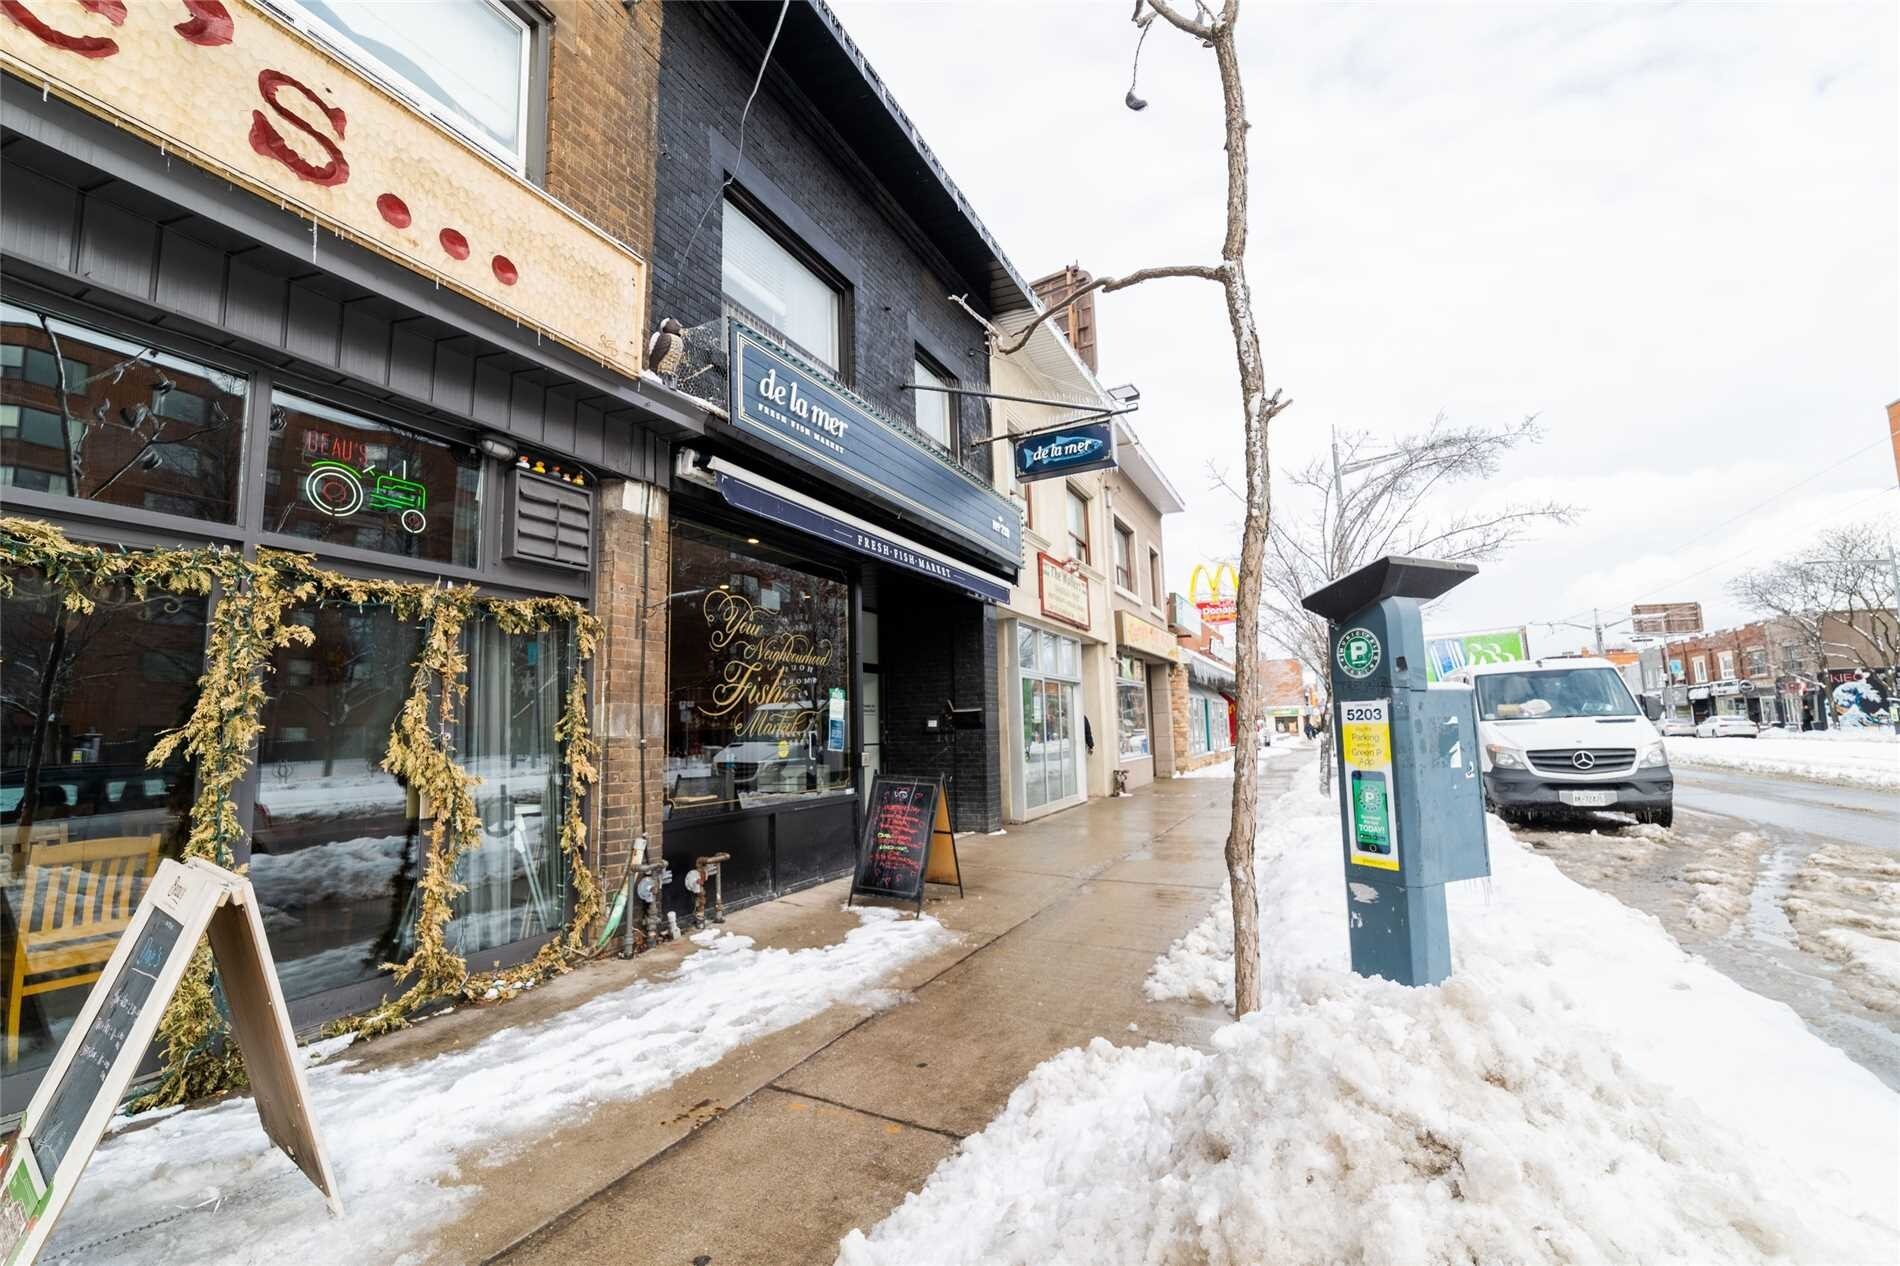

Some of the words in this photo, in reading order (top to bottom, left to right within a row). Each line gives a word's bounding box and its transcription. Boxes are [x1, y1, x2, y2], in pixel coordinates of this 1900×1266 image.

[760, 368, 787, 405] de
[789, 382, 809, 418] la
[811, 405, 849, 438] mer
[758, 403, 787, 424] FRESH
[790, 420, 811, 436] FISH
[814, 432, 844, 454] MARKET
[1033, 445, 1049, 461] de
[1050, 443, 1063, 457] la
[1065, 440, 1092, 456] mer
[857, 535, 890, 556] FRESH
[893, 549, 915, 565] FISH
[918, 558, 951, 578] MARKET
[1347, 708, 1382, 721] 5203
[1352, 733, 1380, 743] Parking
[1352, 747, 1375, 756] Green
[1359, 824, 1385, 833] TODAY!
